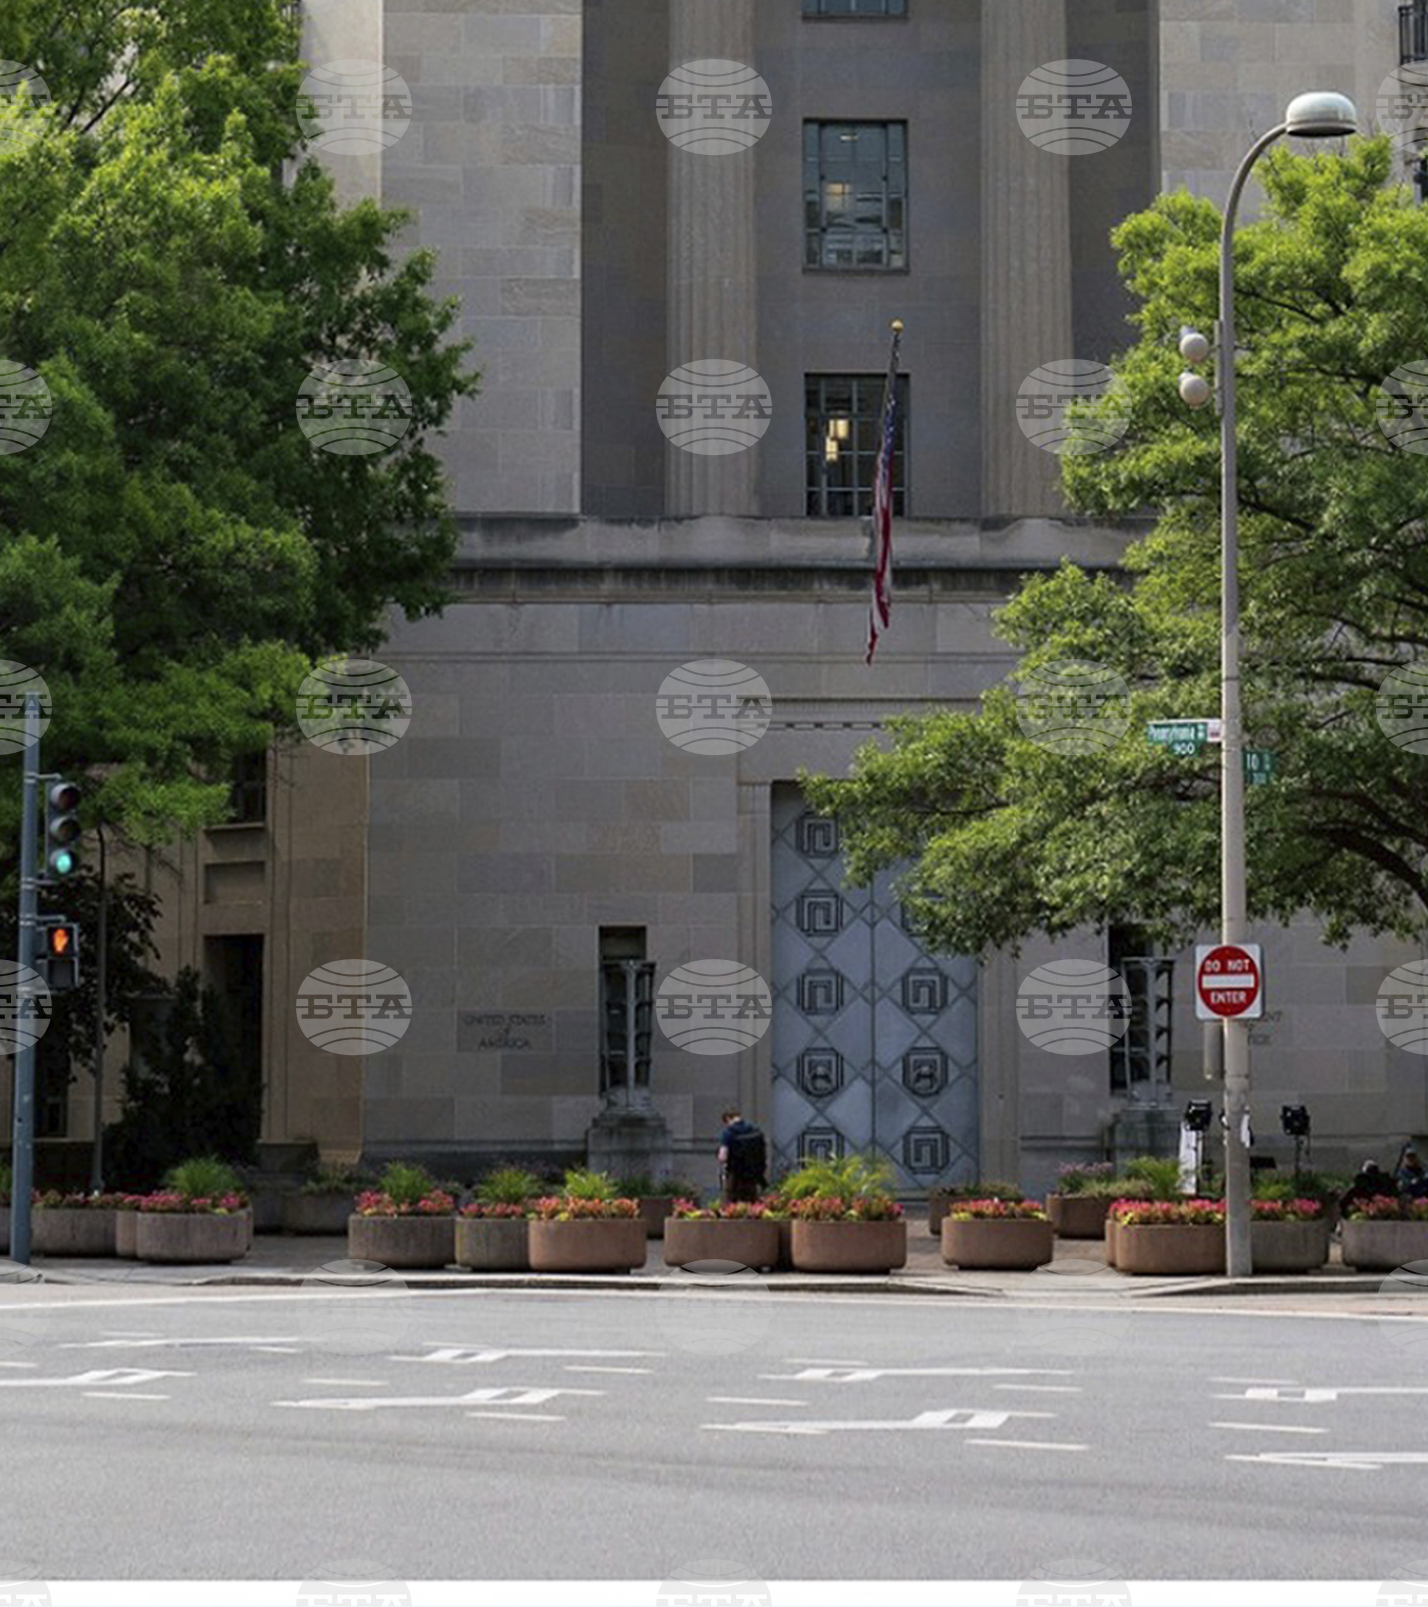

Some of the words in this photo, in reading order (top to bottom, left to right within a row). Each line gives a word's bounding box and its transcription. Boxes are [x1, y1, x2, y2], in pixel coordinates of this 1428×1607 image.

[1204, 959, 1222, 972] DO
[1227, 959, 1251, 972] NOT
[1211, 991, 1247, 1004] ENTER
